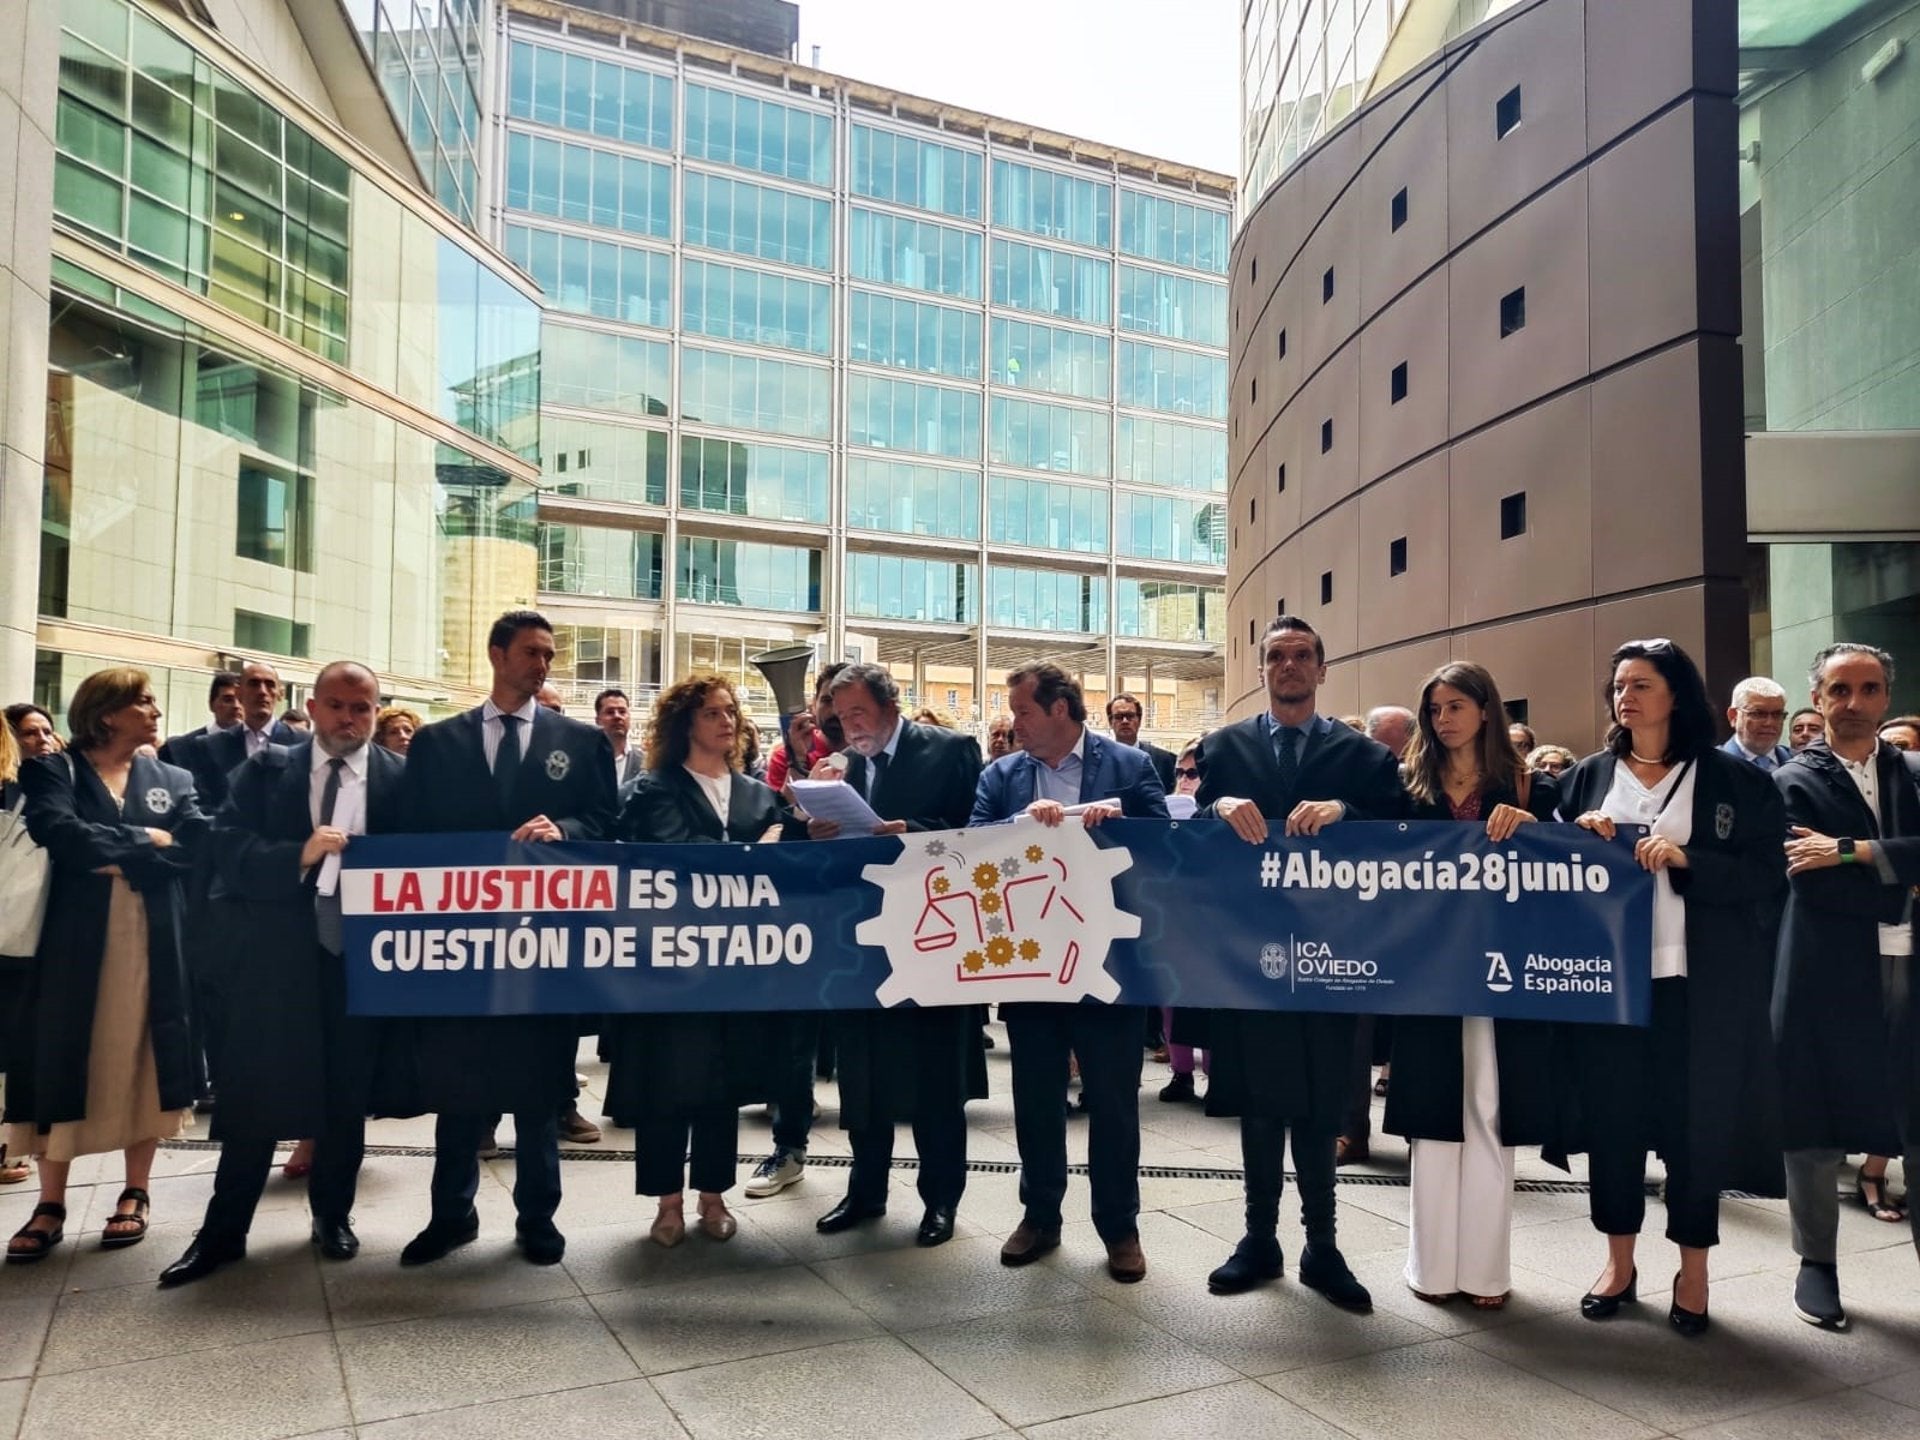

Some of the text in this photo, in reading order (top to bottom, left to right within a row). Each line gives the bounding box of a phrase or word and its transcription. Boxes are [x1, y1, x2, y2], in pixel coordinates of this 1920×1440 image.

[1259, 849, 1611, 903] #Abogacía28junio
[372, 868, 781, 912] LA JUSTICIA ES UNA
[371, 916, 813, 972] CUESTIÓN DE ESTADO
[1296, 941, 1333, 958] ICA
[1297, 958, 1378, 977] OVIEDO
[1524, 953, 1613, 975] Abogacía
[1523, 973, 1613, 994] Española
